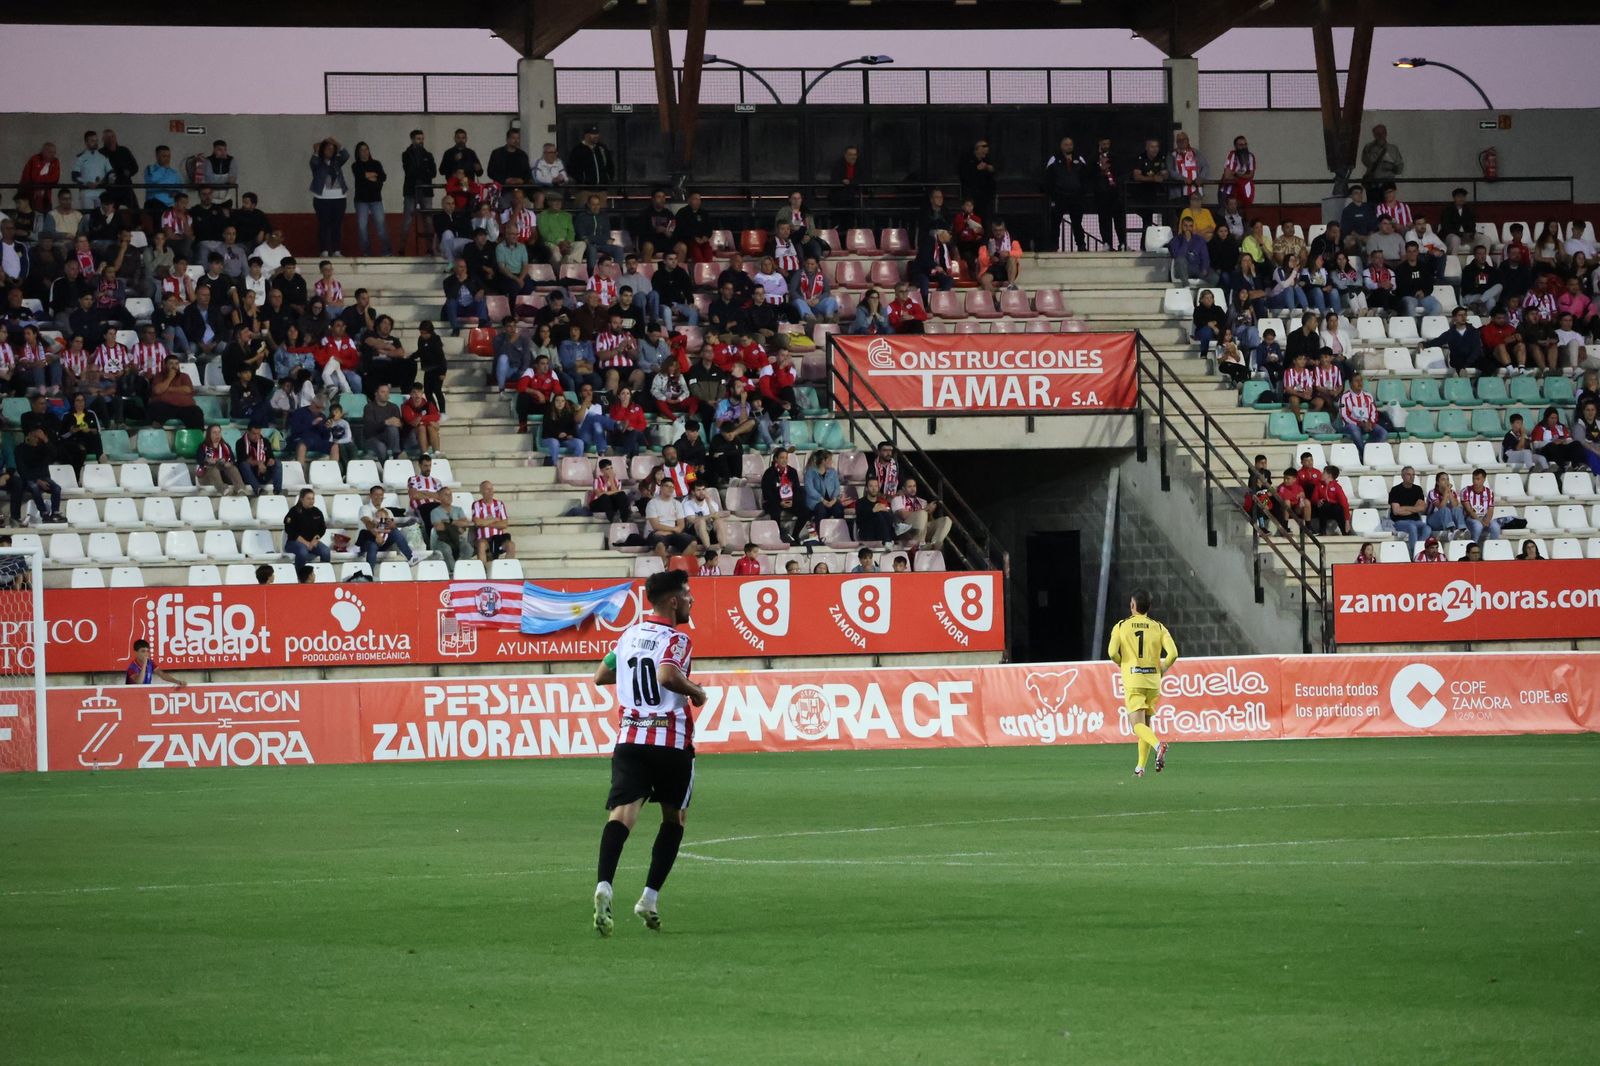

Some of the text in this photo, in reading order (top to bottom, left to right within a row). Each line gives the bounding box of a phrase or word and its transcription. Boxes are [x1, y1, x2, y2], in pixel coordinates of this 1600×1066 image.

[1071, 391, 1104, 406] S.A.
[156, 592, 255, 638] fisio
[756, 587, 780, 626] 8
[858, 585, 881, 624] 8
[961, 582, 983, 621] 8
[727, 606, 765, 652] ZAMORA
[828, 604, 867, 649] ZAMORA
[932, 601, 969, 647] ZAMORA
[158, 626, 271, 662] readapt
[285, 629, 411, 662] podoactiva
[302, 650, 411, 662] PODOLOGÍA Y BIOMECÁNICA
[1134, 630, 1144, 659] 1
[424, 681, 613, 716] PERSIANAS
[627, 656, 661, 707] 10
[1112, 666, 1269, 698] Ecuela
[1295, 682, 1379, 697] Escucha todos
[1450, 681, 1486, 695] COPE
[1519, 689, 1568, 704] COPE.es
[692, 682, 901, 743] ZAMORA
[901, 680, 973, 738] CF
[1295, 704, 1380, 720] los partidos en
[1452, 696, 1512, 710] ZAMORA
[137, 730, 315, 769] ZAMORA
[372, 718, 618, 760] ZAMORANAS
